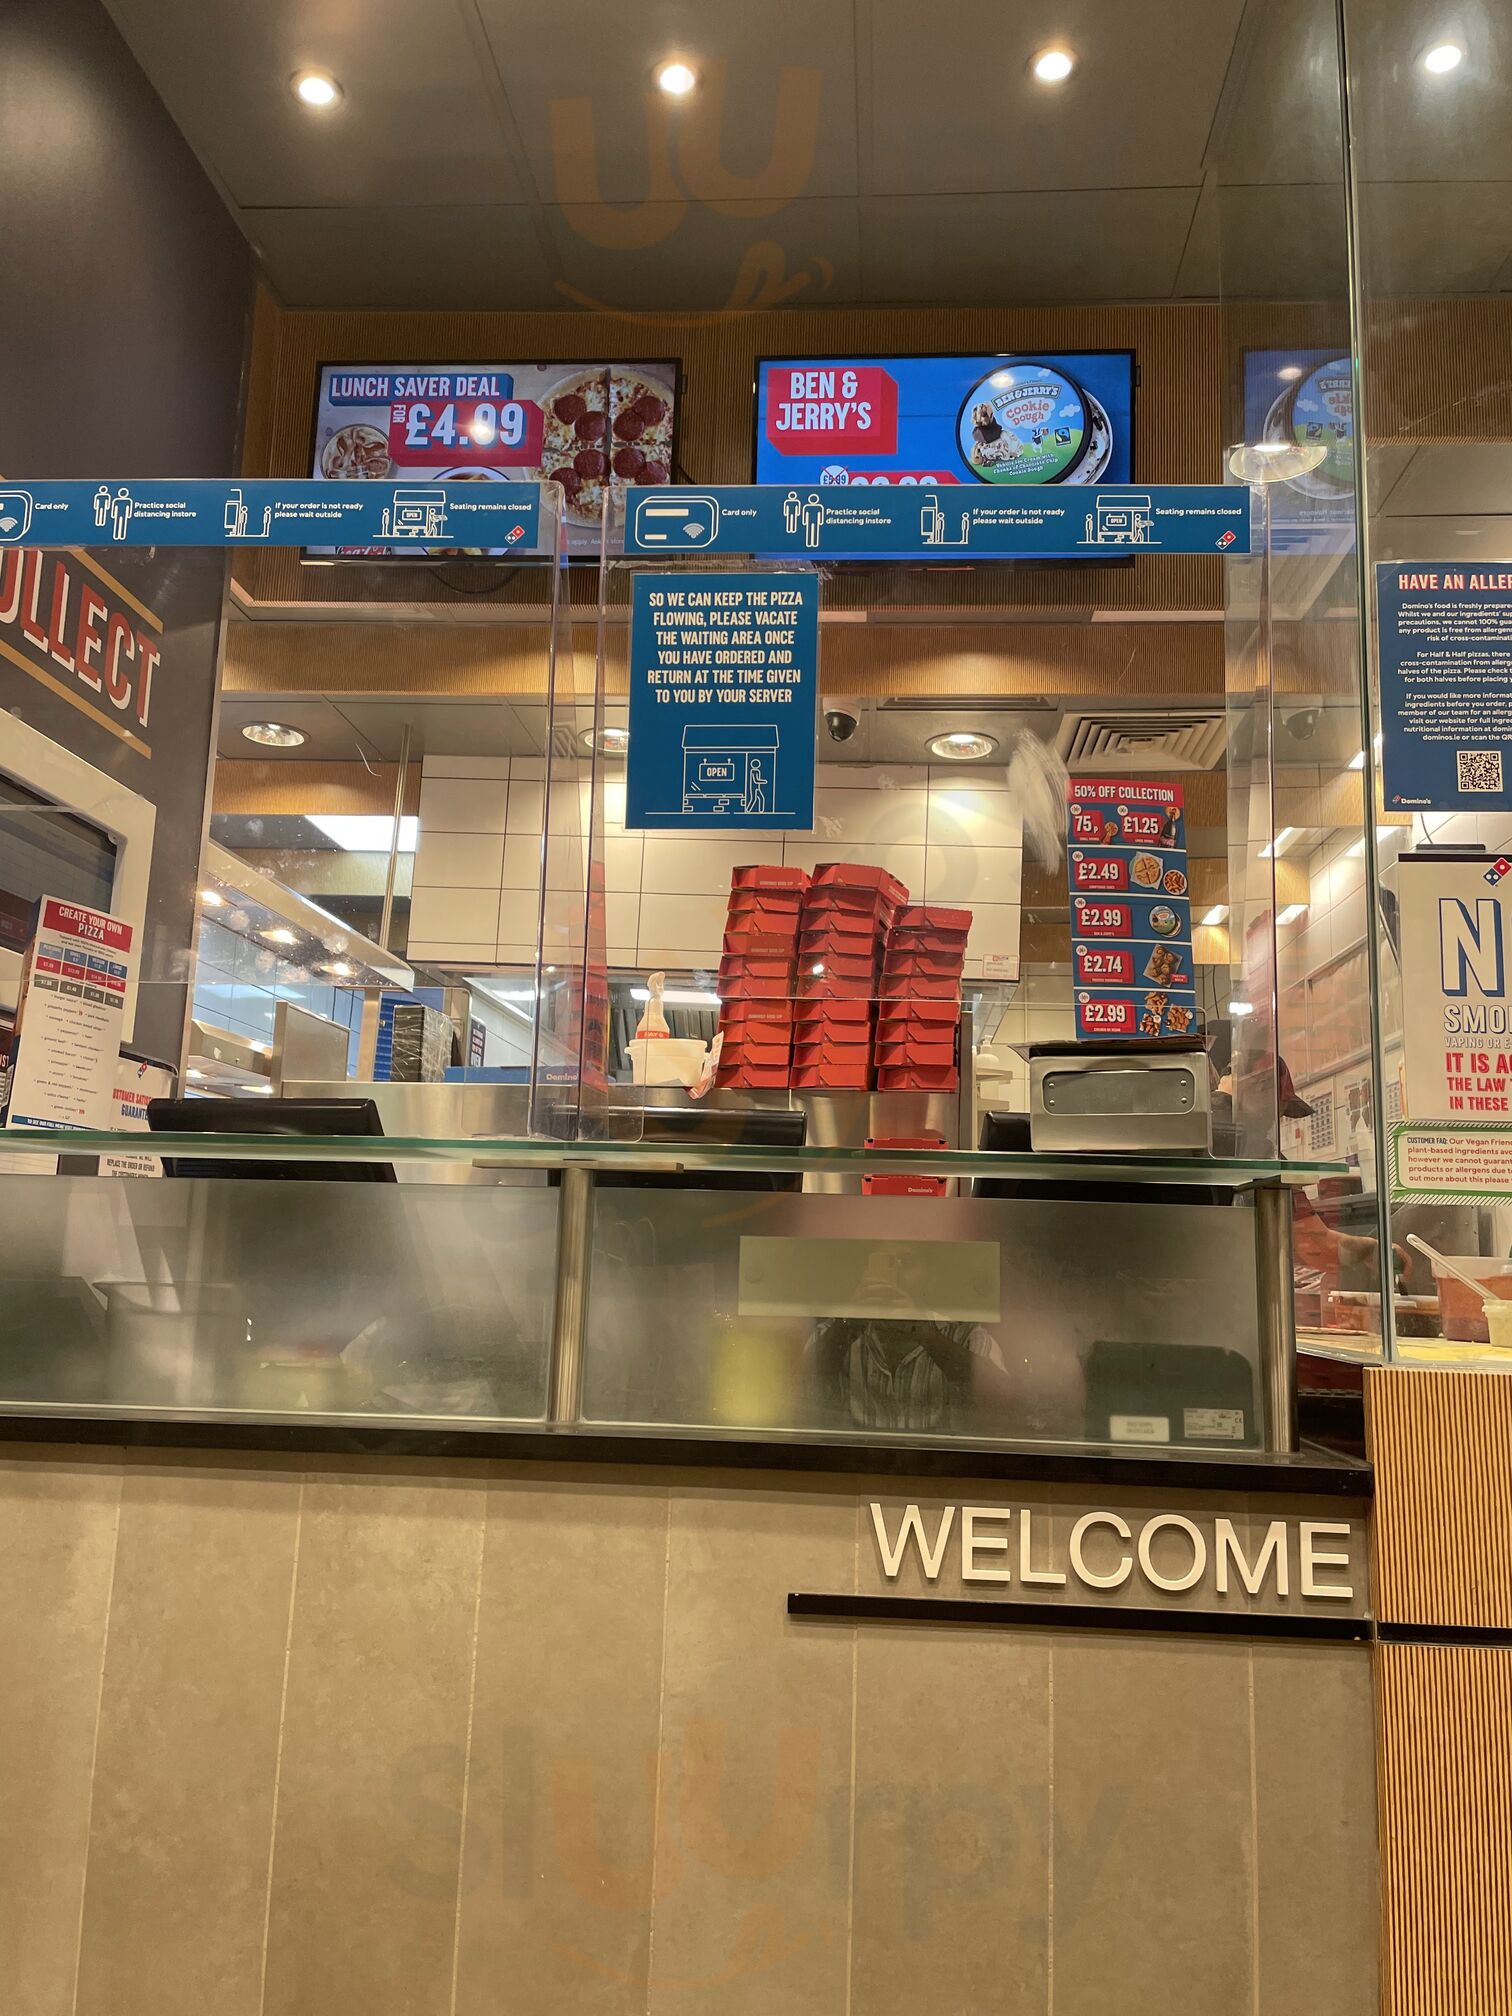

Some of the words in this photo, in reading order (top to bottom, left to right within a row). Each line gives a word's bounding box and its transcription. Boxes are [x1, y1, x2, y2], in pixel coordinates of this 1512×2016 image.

[328, 376, 388, 397] LUNCH
[394, 376, 450, 396] SAVER
[456, 376, 500, 396] DEAL
[791, 372, 835, 398] BEN
[842, 371, 858, 398] &
[392, 404, 406, 424] FOR
[776, 402, 871, 430] JERRY'S
[405, 402, 524, 446] £4.99
[450, 503, 477, 511] Seating
[741, 509, 757, 517] only
[1156, 508, 1184, 516] Seating
[1399, 575, 1438, 589] HAVE
[1443, 575, 1463, 589] AN
[649, 593, 664, 606] SO
[667, 593, 685, 606] WE
[688, 593, 711, 606] CAN
[714, 592, 743, 606] KEEP
[746, 592, 768, 605] THE
[771, 592, 803, 605] PIZZA
[1458, 602, 1482, 610] freshly
[654, 612, 707, 627] FLOWING,
[710, 612, 752, 625] PLEASE
[755, 611, 798, 625] VACATE
[1460, 610, 1501, 618] ingredients'
[656, 632, 677, 645] THE
[681, 631, 728, 644] WAITING
[731, 631, 762, 644] AREA
[765, 631, 794, 644] ONCE
[1412, 627, 1440, 635] product
[658, 651, 680, 664] YOU
[683, 651, 712, 664] HAVE
[715, 650, 765, 664] ORDERED
[768, 650, 792, 663] AND
[648, 670, 691, 683] RETURN
[694, 670, 709, 683] AT
[712, 670, 734, 683] THE
[737, 670, 764, 683] TIME
[767, 670, 800, 683] GIVEN
[655, 690, 670, 703] TO
[673, 690, 695, 703] YOU
[698, 690, 713, 702] BY
[716, 689, 746, 702] YOUR
[749, 689, 792, 702] SERVER
[707, 768, 727, 776] OPEN
[1075, 785, 1096, 798] 50%
[1099, 786, 1116, 798] OFF
[1119, 787, 1173, 801] COLLECTION
[1124, 817, 1159, 834] £1.25
[1079, 863, 1119, 880] £2.49
[59, 906, 87, 923] CREATE
[88, 914, 106, 929] YOUR
[107, 922, 123, 936] OWN
[1081, 909, 1122, 926] £2.99
[78, 923, 105, 941] PIZZA
[1439, 898, 1512, 997] N
[1084, 956, 1123, 973] £2.74
[1086, 1005, 1126, 1022] £2.99
[1444, 1037, 1484, 1048] VAPING
[1486, 1037, 1501, 1049] OR
[1446, 1053, 1463, 1072] IT
[1471, 1053, 1489, 1072] IS
[1447, 1077, 1472, 1091] THE
[1477, 1078, 1506, 1092] LAW
[1450, 1096, 1463, 1109] IN
[1467, 1097, 1508, 1111] THESE
[1436, 1137, 1448, 1145] FAQ:
[1466, 1138, 1489, 1147] Vegan
[1408, 1146, 1453, 1155] plant-based
[1455, 1147, 1499, 1157] ingredients
[1455, 1157, 1482, 1165] cannot
[1409, 1165, 1443, 1174] products
[1455, 1166, 1490, 1175] allergens
[1469, 1175, 1483, 1183] this
[1485, 1176, 1509, 1184] please
[870, 1503, 1353, 1598] WELCOME
